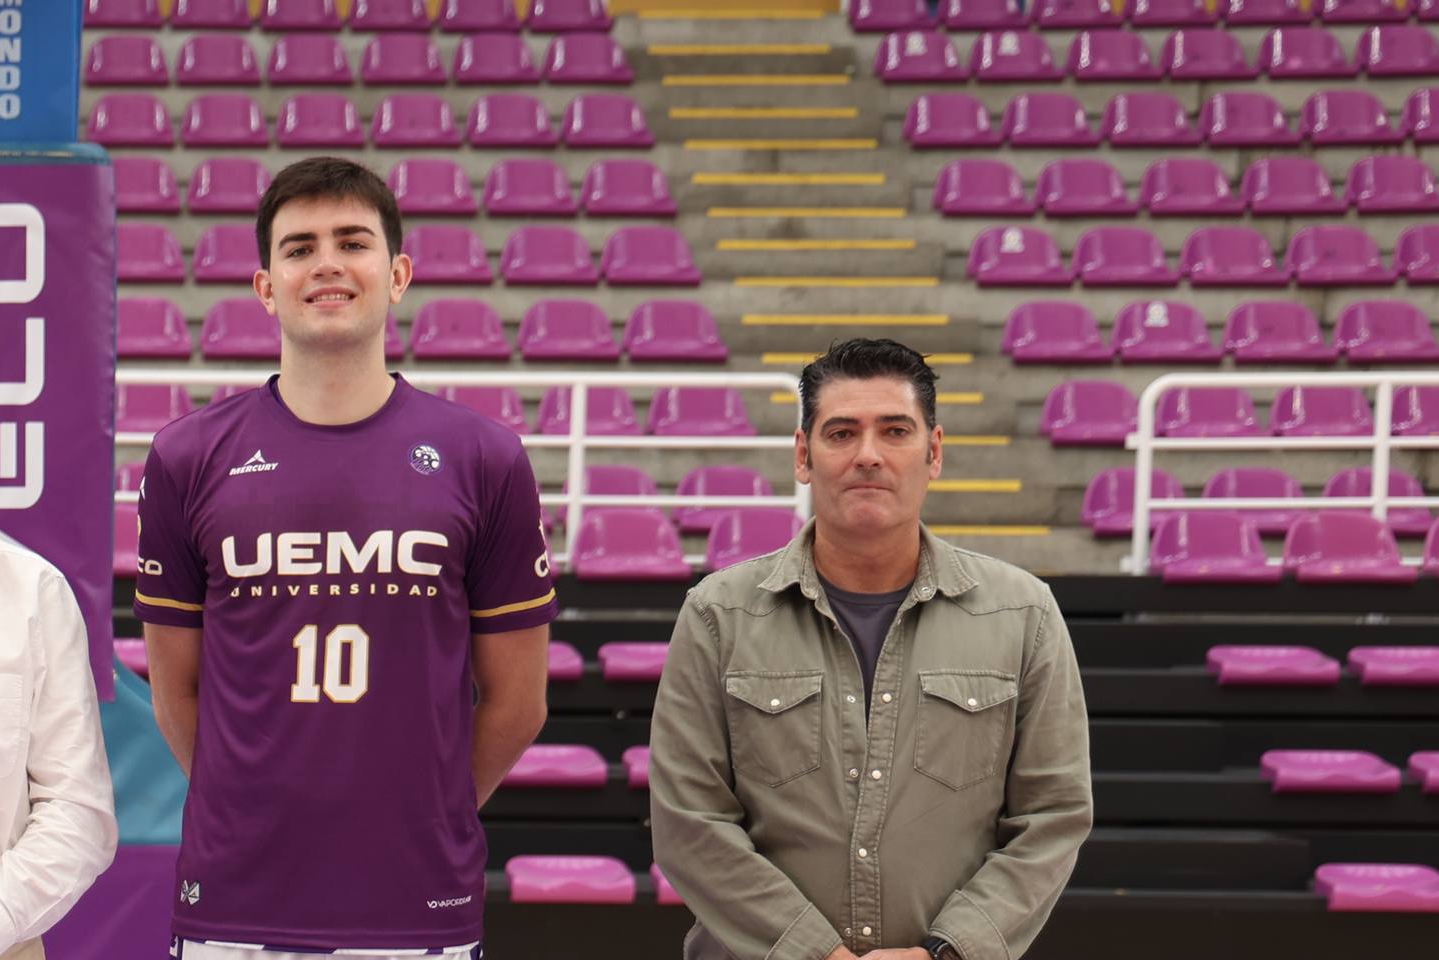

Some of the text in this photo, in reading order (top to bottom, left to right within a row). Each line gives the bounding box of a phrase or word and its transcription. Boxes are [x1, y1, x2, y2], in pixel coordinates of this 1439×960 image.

[228, 461, 279, 476] MERCURY
[221, 530, 449, 579] UEMC
[230, 584, 438, 598] UNIVERSIDAD
[291, 624, 369, 704] 10
